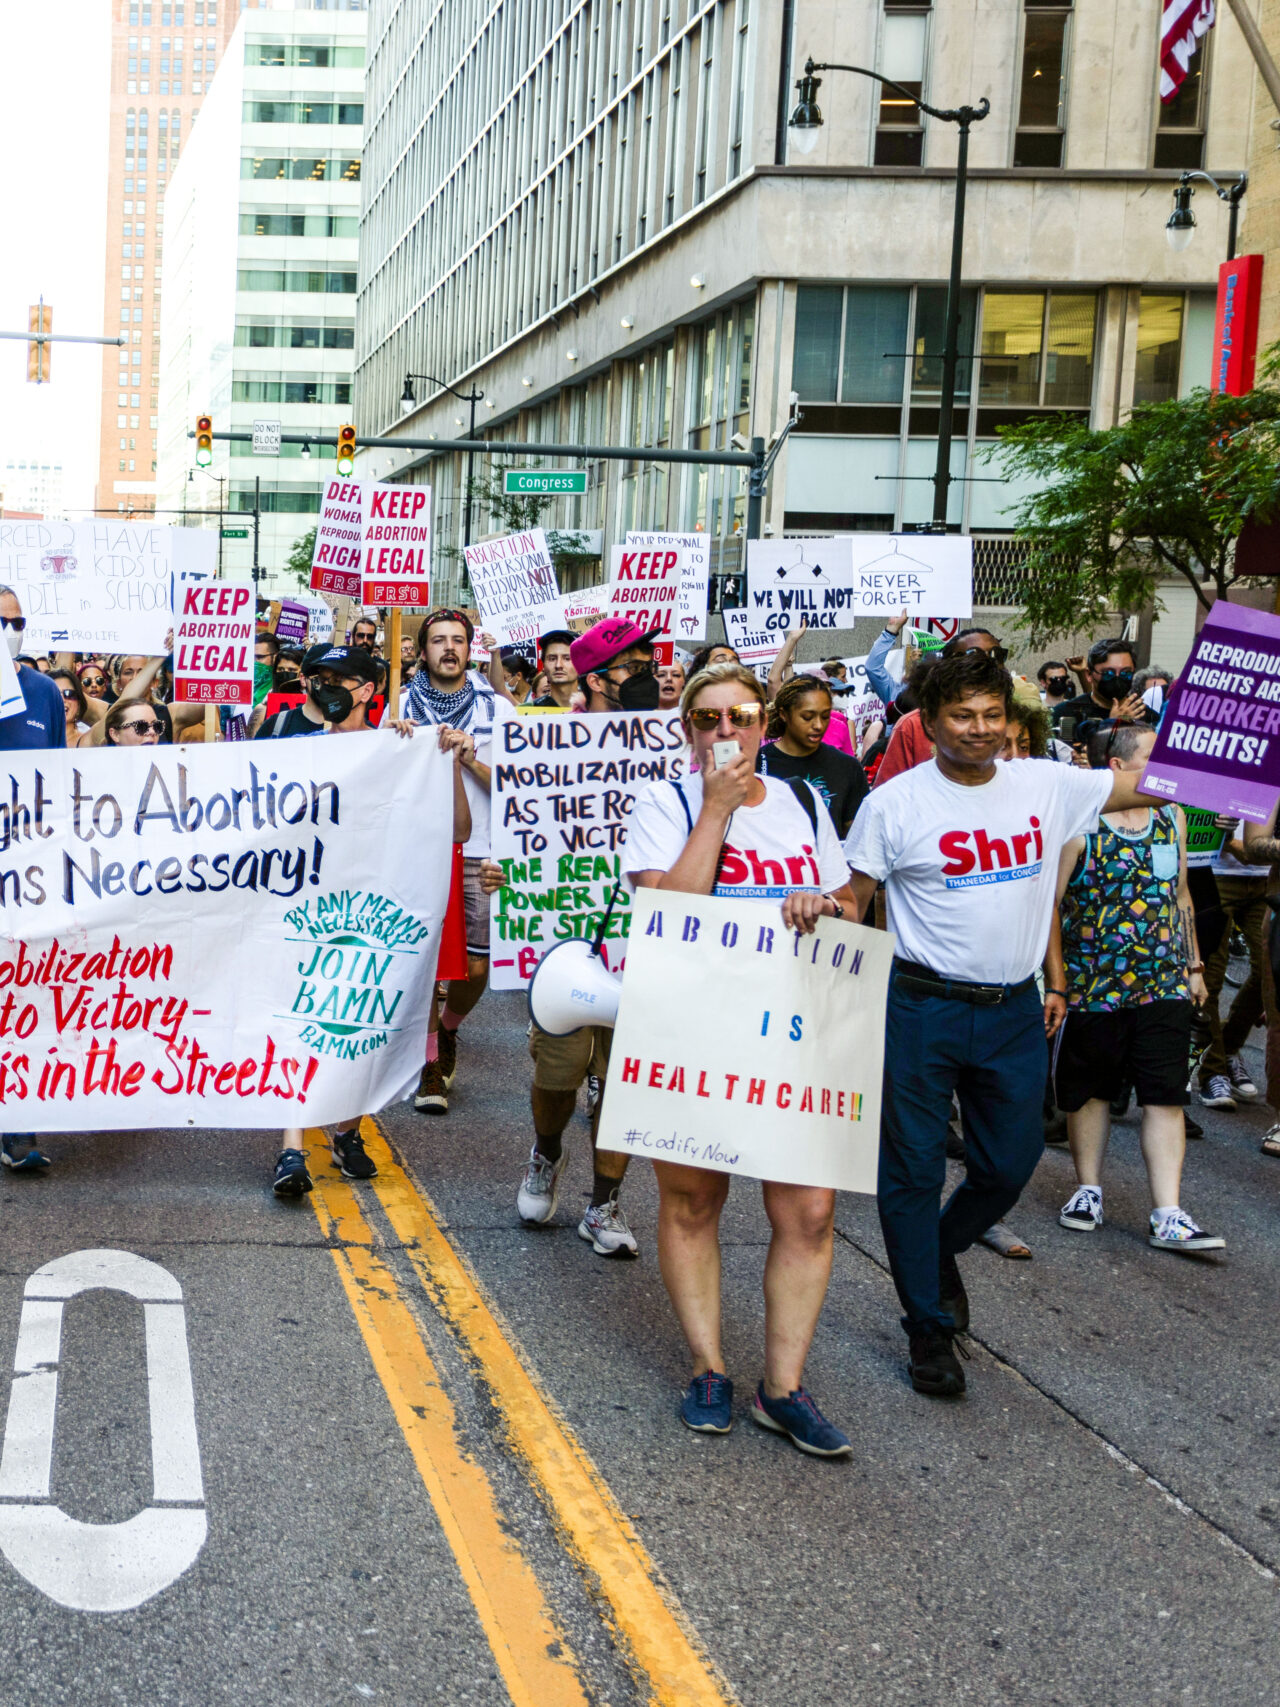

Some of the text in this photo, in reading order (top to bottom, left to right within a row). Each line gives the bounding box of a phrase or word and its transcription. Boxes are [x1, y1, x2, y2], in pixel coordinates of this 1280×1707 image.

[255, 436, 279, 444] BLOCK
[518, 476, 574, 489] Congress
[372, 491, 425, 519] KEEP
[63, 526, 75, 548] 2
[93, 525, 163, 554] HAVE
[365, 525, 427, 541] ABORTION
[365, 548, 425, 574] LEGAL
[465, 533, 535, 566] ABORTION
[691, 554, 703, 563] TO
[94, 555, 145, 577] KIDS
[153, 558, 168, 579] U
[470, 552, 550, 581] IS PERSONAL
[527, 566, 553, 587] NOT
[618, 552, 677, 580] KEEP
[611, 586, 677, 603] ABORTION
[861, 574, 921, 588] NEVER
[27, 582, 66, 615] DIE
[80, 599, 91, 611] in
[183, 587, 249, 616] KEEP
[479, 584, 557, 617] A LEGAL DEBATE
[564, 606, 600, 617] ABORTION
[753, 588, 853, 611] WE WILL NOT
[854, 590, 926, 605] FORGET
[178, 622, 251, 639] ABORTION
[509, 623, 541, 642] BODY
[766, 612, 838, 630] GO BACK
[734, 635, 775, 648] COURT
[178, 644, 248, 672] LEGAL
[1187, 665, 1254, 695] RIGHTS
[502, 717, 684, 753] BUILD MASS
[1167, 721, 1269, 765] RIGHTS!
[495, 756, 684, 792] MOBILIZATIONS
[70, 767, 122, 842] to
[134, 761, 340, 836] Abortion
[503, 792, 597, 828] AS THE
[513, 830, 548, 856] TO
[939, 815, 1043, 876] Shri
[62, 835, 325, 905] Necessary!
[498, 857, 543, 886] THE
[719, 844, 819, 885] Shri
[716, 887, 780, 897] THANEDAR for
[947, 873, 1009, 887] THANEDAR for
[499, 885, 630, 915] POWER IS
[284, 890, 429, 946] BY ANY MEANS
[308, 912, 406, 949] NECESSARY
[494, 913, 544, 942] THE
[645, 910, 864, 976] ABORTION
[297, 945, 394, 986] JOIN
[290, 980, 403, 1025] BAMN
[570, 988, 597, 1005] PYLE
[760, 1011, 803, 1041] IS
[298, 1023, 389, 1061] BAMN.COM
[37, 1045, 76, 1101] in
[82, 1035, 146, 1099] the
[151, 1034, 319, 1105] Streets!
[702, 1142, 740, 1165] Now
